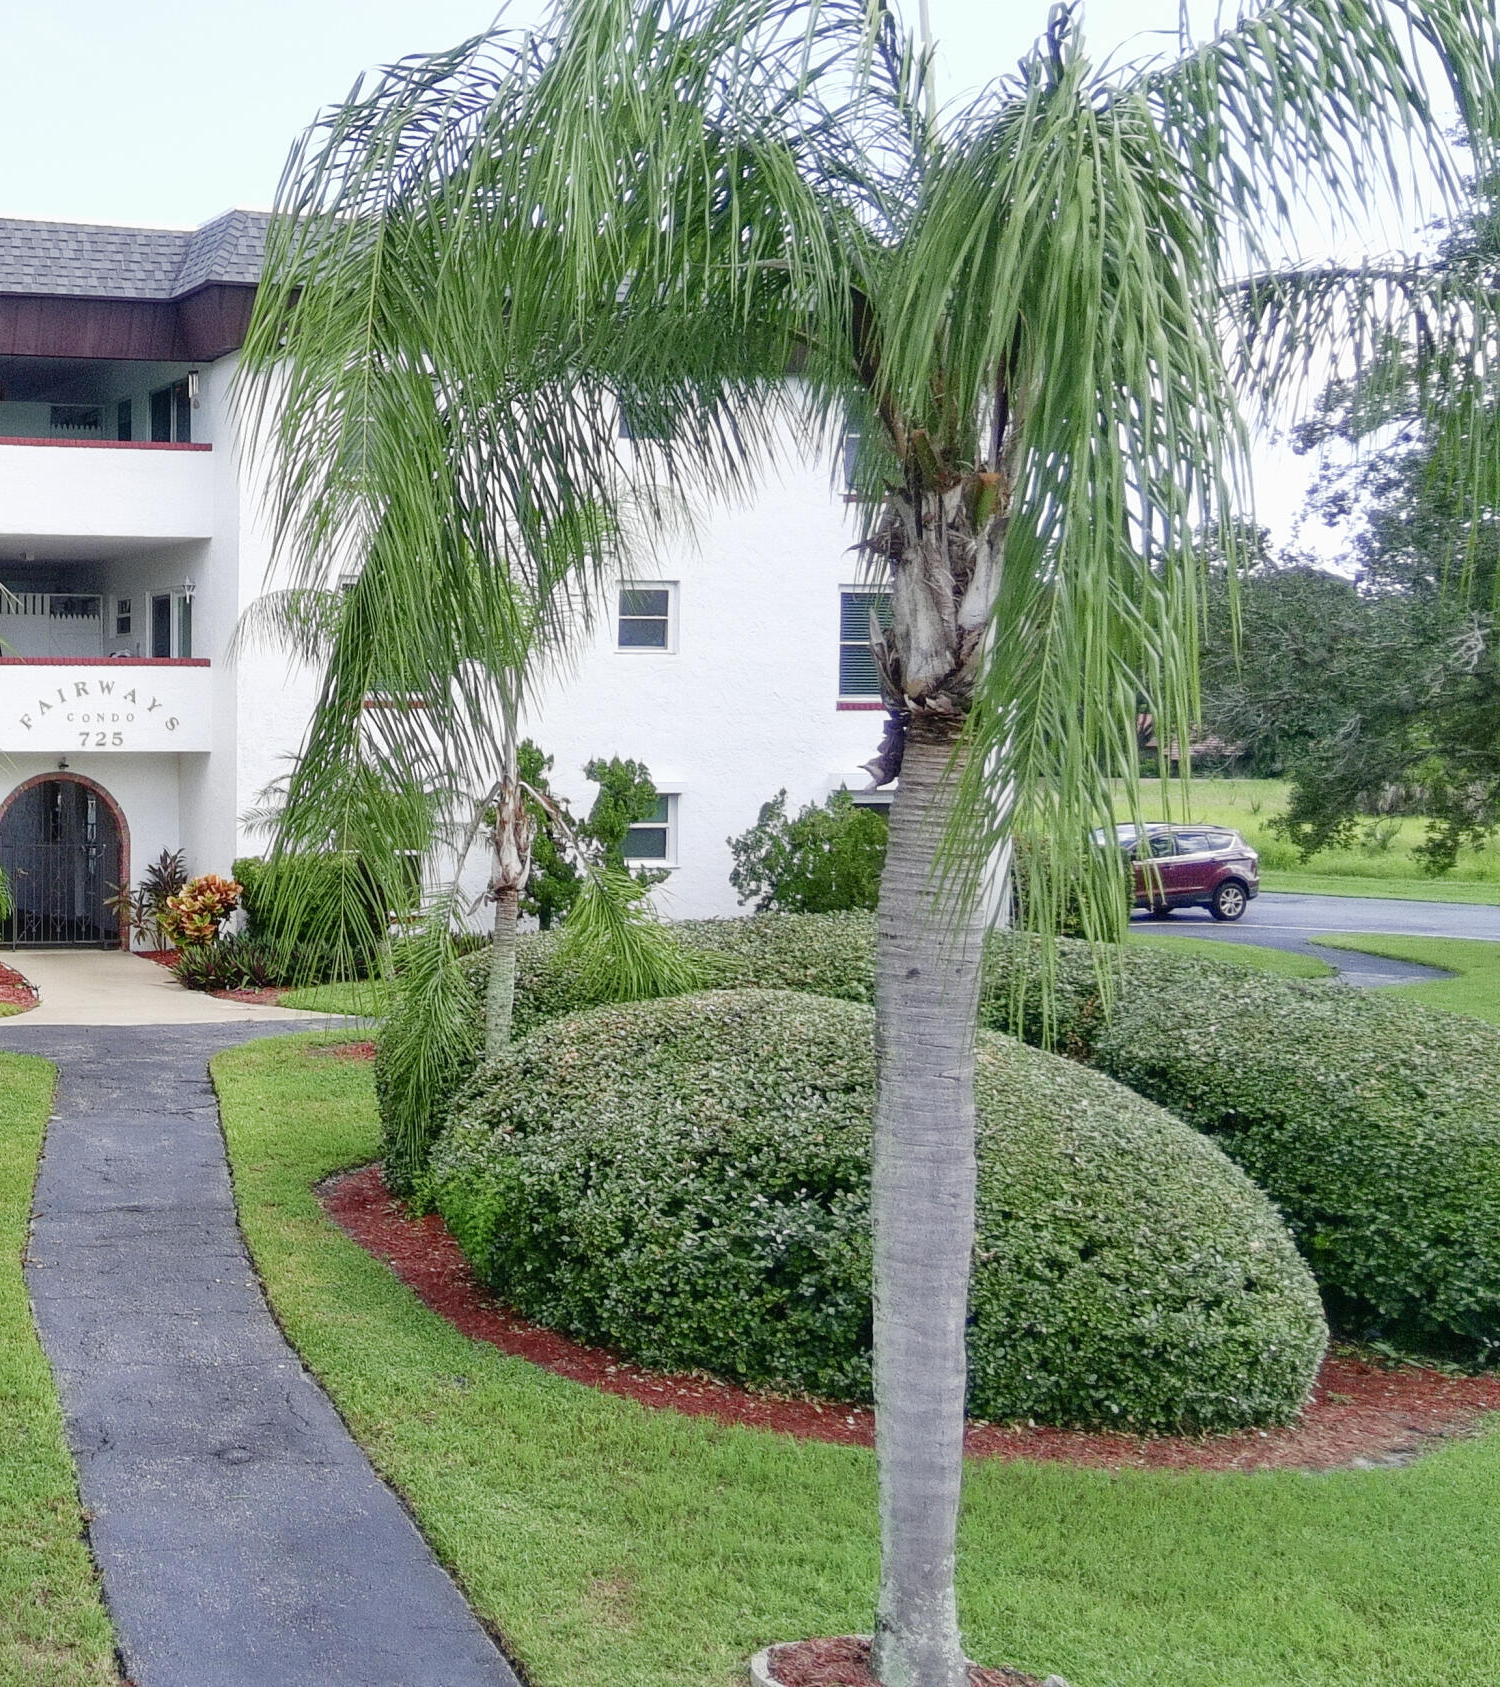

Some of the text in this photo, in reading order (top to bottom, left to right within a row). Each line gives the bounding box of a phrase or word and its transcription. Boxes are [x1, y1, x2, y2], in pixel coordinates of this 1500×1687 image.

[19, 680, 180, 731] FAIRWAYS
[66, 712, 135, 723] CONDO
[78, 731, 124, 747] 725
